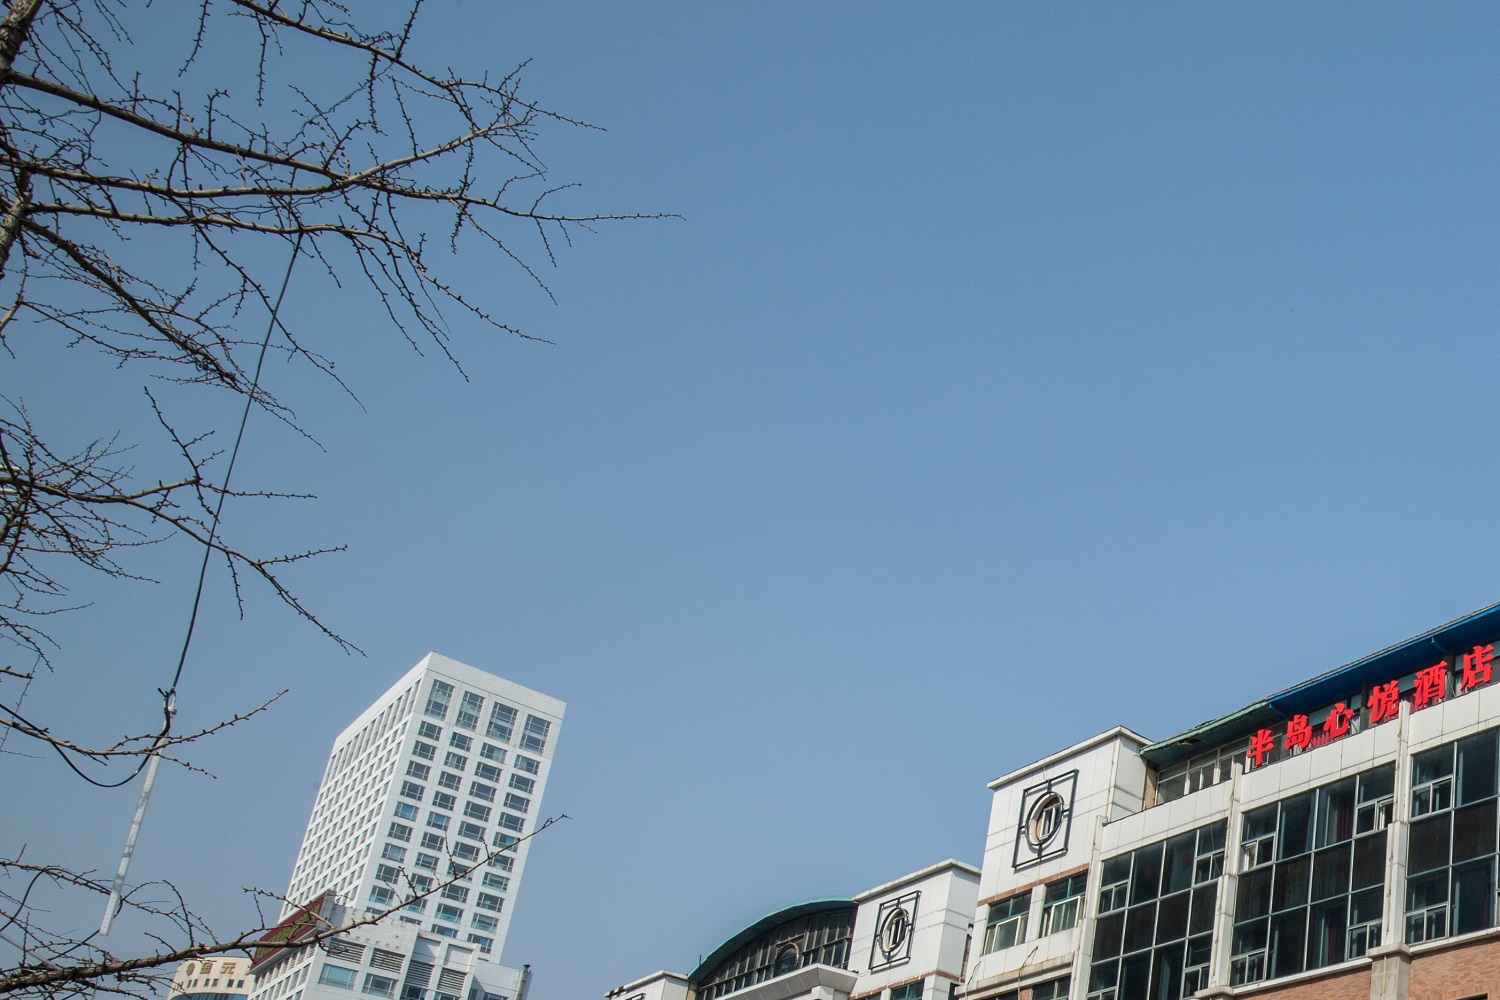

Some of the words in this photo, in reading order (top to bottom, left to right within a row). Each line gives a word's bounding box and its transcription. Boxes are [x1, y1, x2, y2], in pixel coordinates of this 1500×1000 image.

[1247, 643, 1495, 766] 半岛心悦酒店
